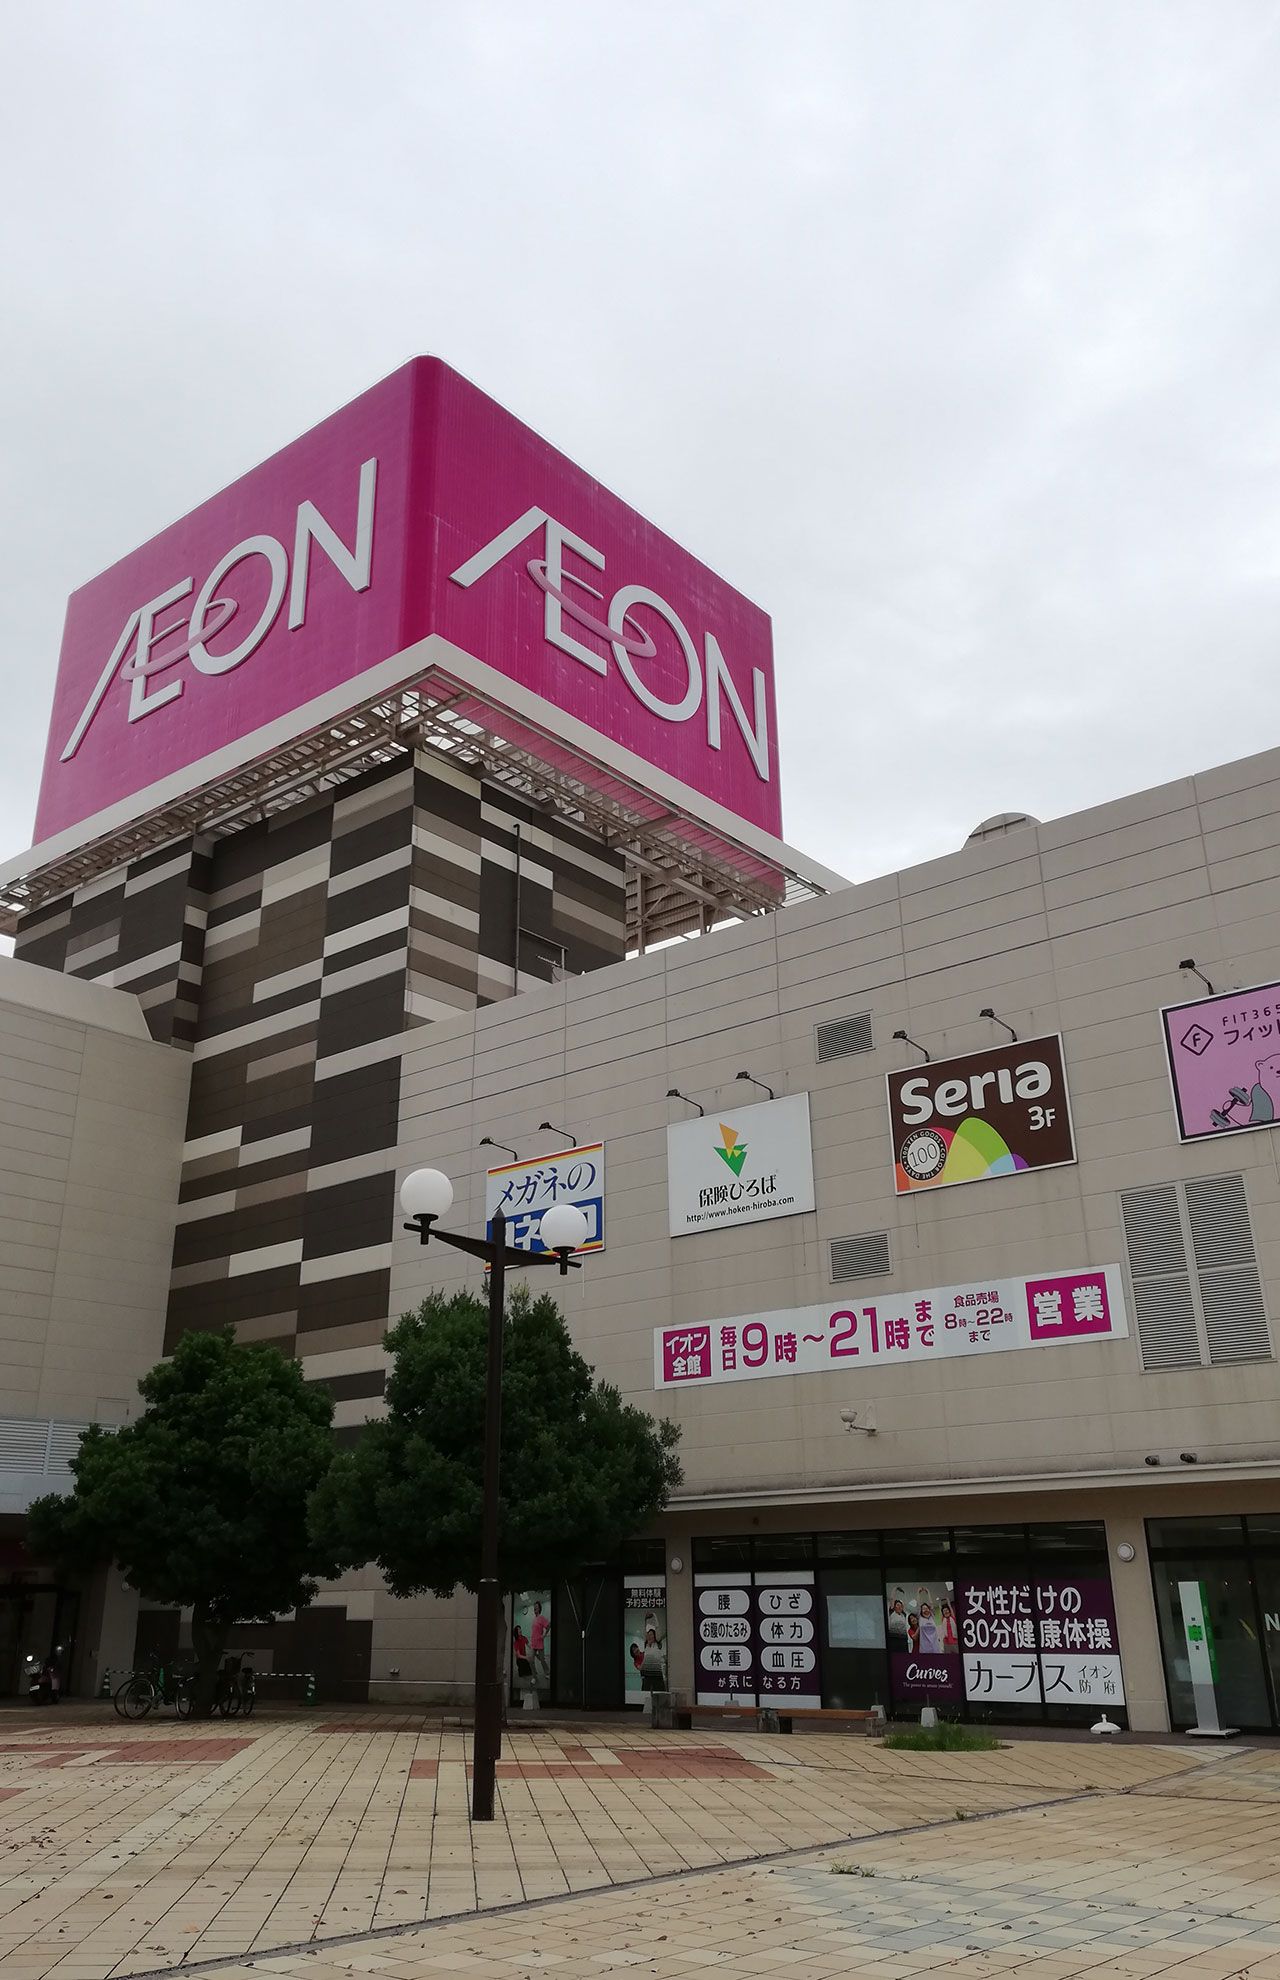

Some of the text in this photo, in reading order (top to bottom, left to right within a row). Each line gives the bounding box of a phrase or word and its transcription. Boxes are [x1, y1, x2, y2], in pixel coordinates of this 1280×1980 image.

[900, 1061, 1052, 1125] Seria
[1028, 1105, 1056, 1131] 3F
[910, 1143, 937, 1168] 100
[494, 1162, 596, 1211] メガネの
[699, 1174, 777, 1208] 保険ひろば
[686, 1196, 795, 1223] http://www.hoken-hiroba.com
[954, 1290, 999, 1308] 食品売場
[1033, 1285, 1104, 1327] 営業
[914, 1299, 935, 1347] まで
[666, 1332, 707, 1355] イオン
[968, 1329, 991, 1343] まで
[720, 1325, 737, 1371] 毎日
[672, 1354, 701, 1377] 全館
[718, 1594, 730, 1610] 腰
[770, 1593, 801, 1610] ひざ
[965, 1585, 1082, 1616] 女性だけの
[703, 1622, 748, 1638] お腹のたるみ
[771, 1622, 803, 1639] 体力
[963, 1618, 1112, 1650] 30分健康体操
[710, 1650, 741, 1667] 体重
[772, 1651, 804, 1668] 血圧
[906, 1663, 948, 1682] Curves
[969, 1660, 1074, 1693] カーブス
[1078, 1665, 1113, 1679] イオン
[1078, 1679, 1117, 1695] 防府
